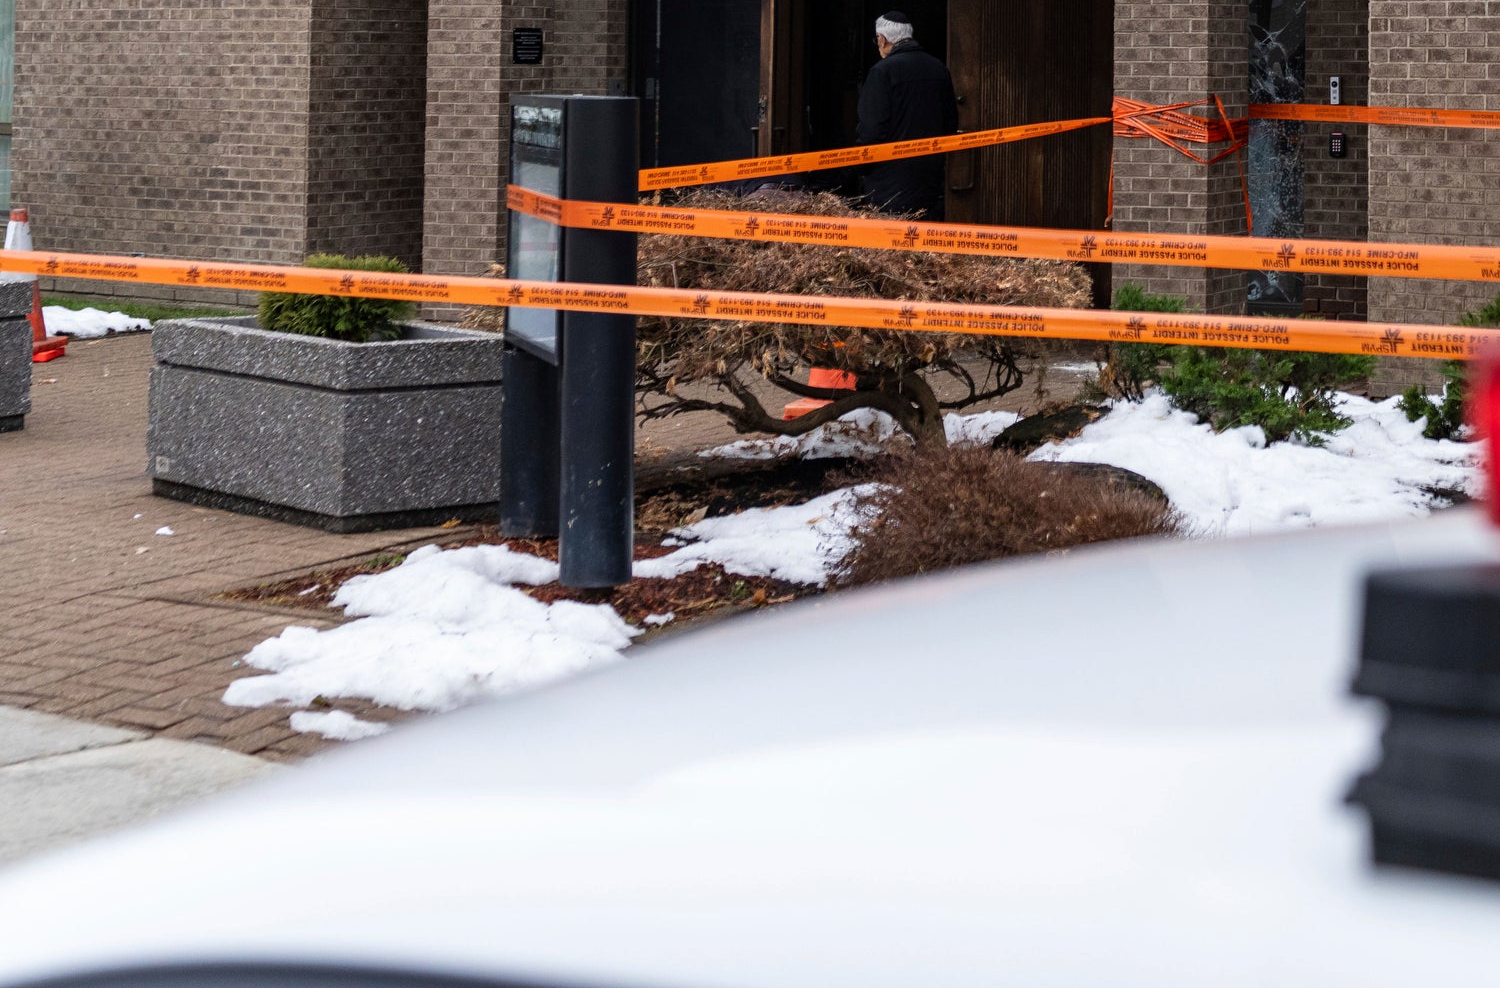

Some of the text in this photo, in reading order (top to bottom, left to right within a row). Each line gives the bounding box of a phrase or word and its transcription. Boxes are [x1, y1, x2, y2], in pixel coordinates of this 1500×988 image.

[959, 230, 971, 239] 514
[976, 231, 1017, 241] INFO-CRIME
[923, 238, 1018, 251] POLICE PASSAGE INTERDIT
[1141, 240, 1154, 248] 514
[1159, 240, 1206, 250] INFO-CRIME
[1101, 249, 1206, 261] POLICE PASSAGE INTERDIT
[1305, 247, 1418, 259] INFO-CRIME 514 393-1133
[1300, 257, 1418, 271] POLICE PASSAGE INTERDIT
[756, 299, 770, 307] 514
[775, 300, 824, 310] INFO-CRIME
[716, 307, 826, 320] POLICE PASSAGE INTERDIT
[967, 310, 982, 319] 514
[989, 311, 1042, 322] INFO-CRIME
[923, 318, 1045, 332] POLICE PASSAGE INTERDIT
[1157, 319, 1288, 333] INFO-CRIME 514 393-1133
[1152, 330, 1289, 345] POLICE PASSAGE INTERDIT
[1416, 332, 1465, 343] 393-1133
[1361, 342, 1389, 353] SPVM
[1411, 343, 1464, 354] INTERDIT
